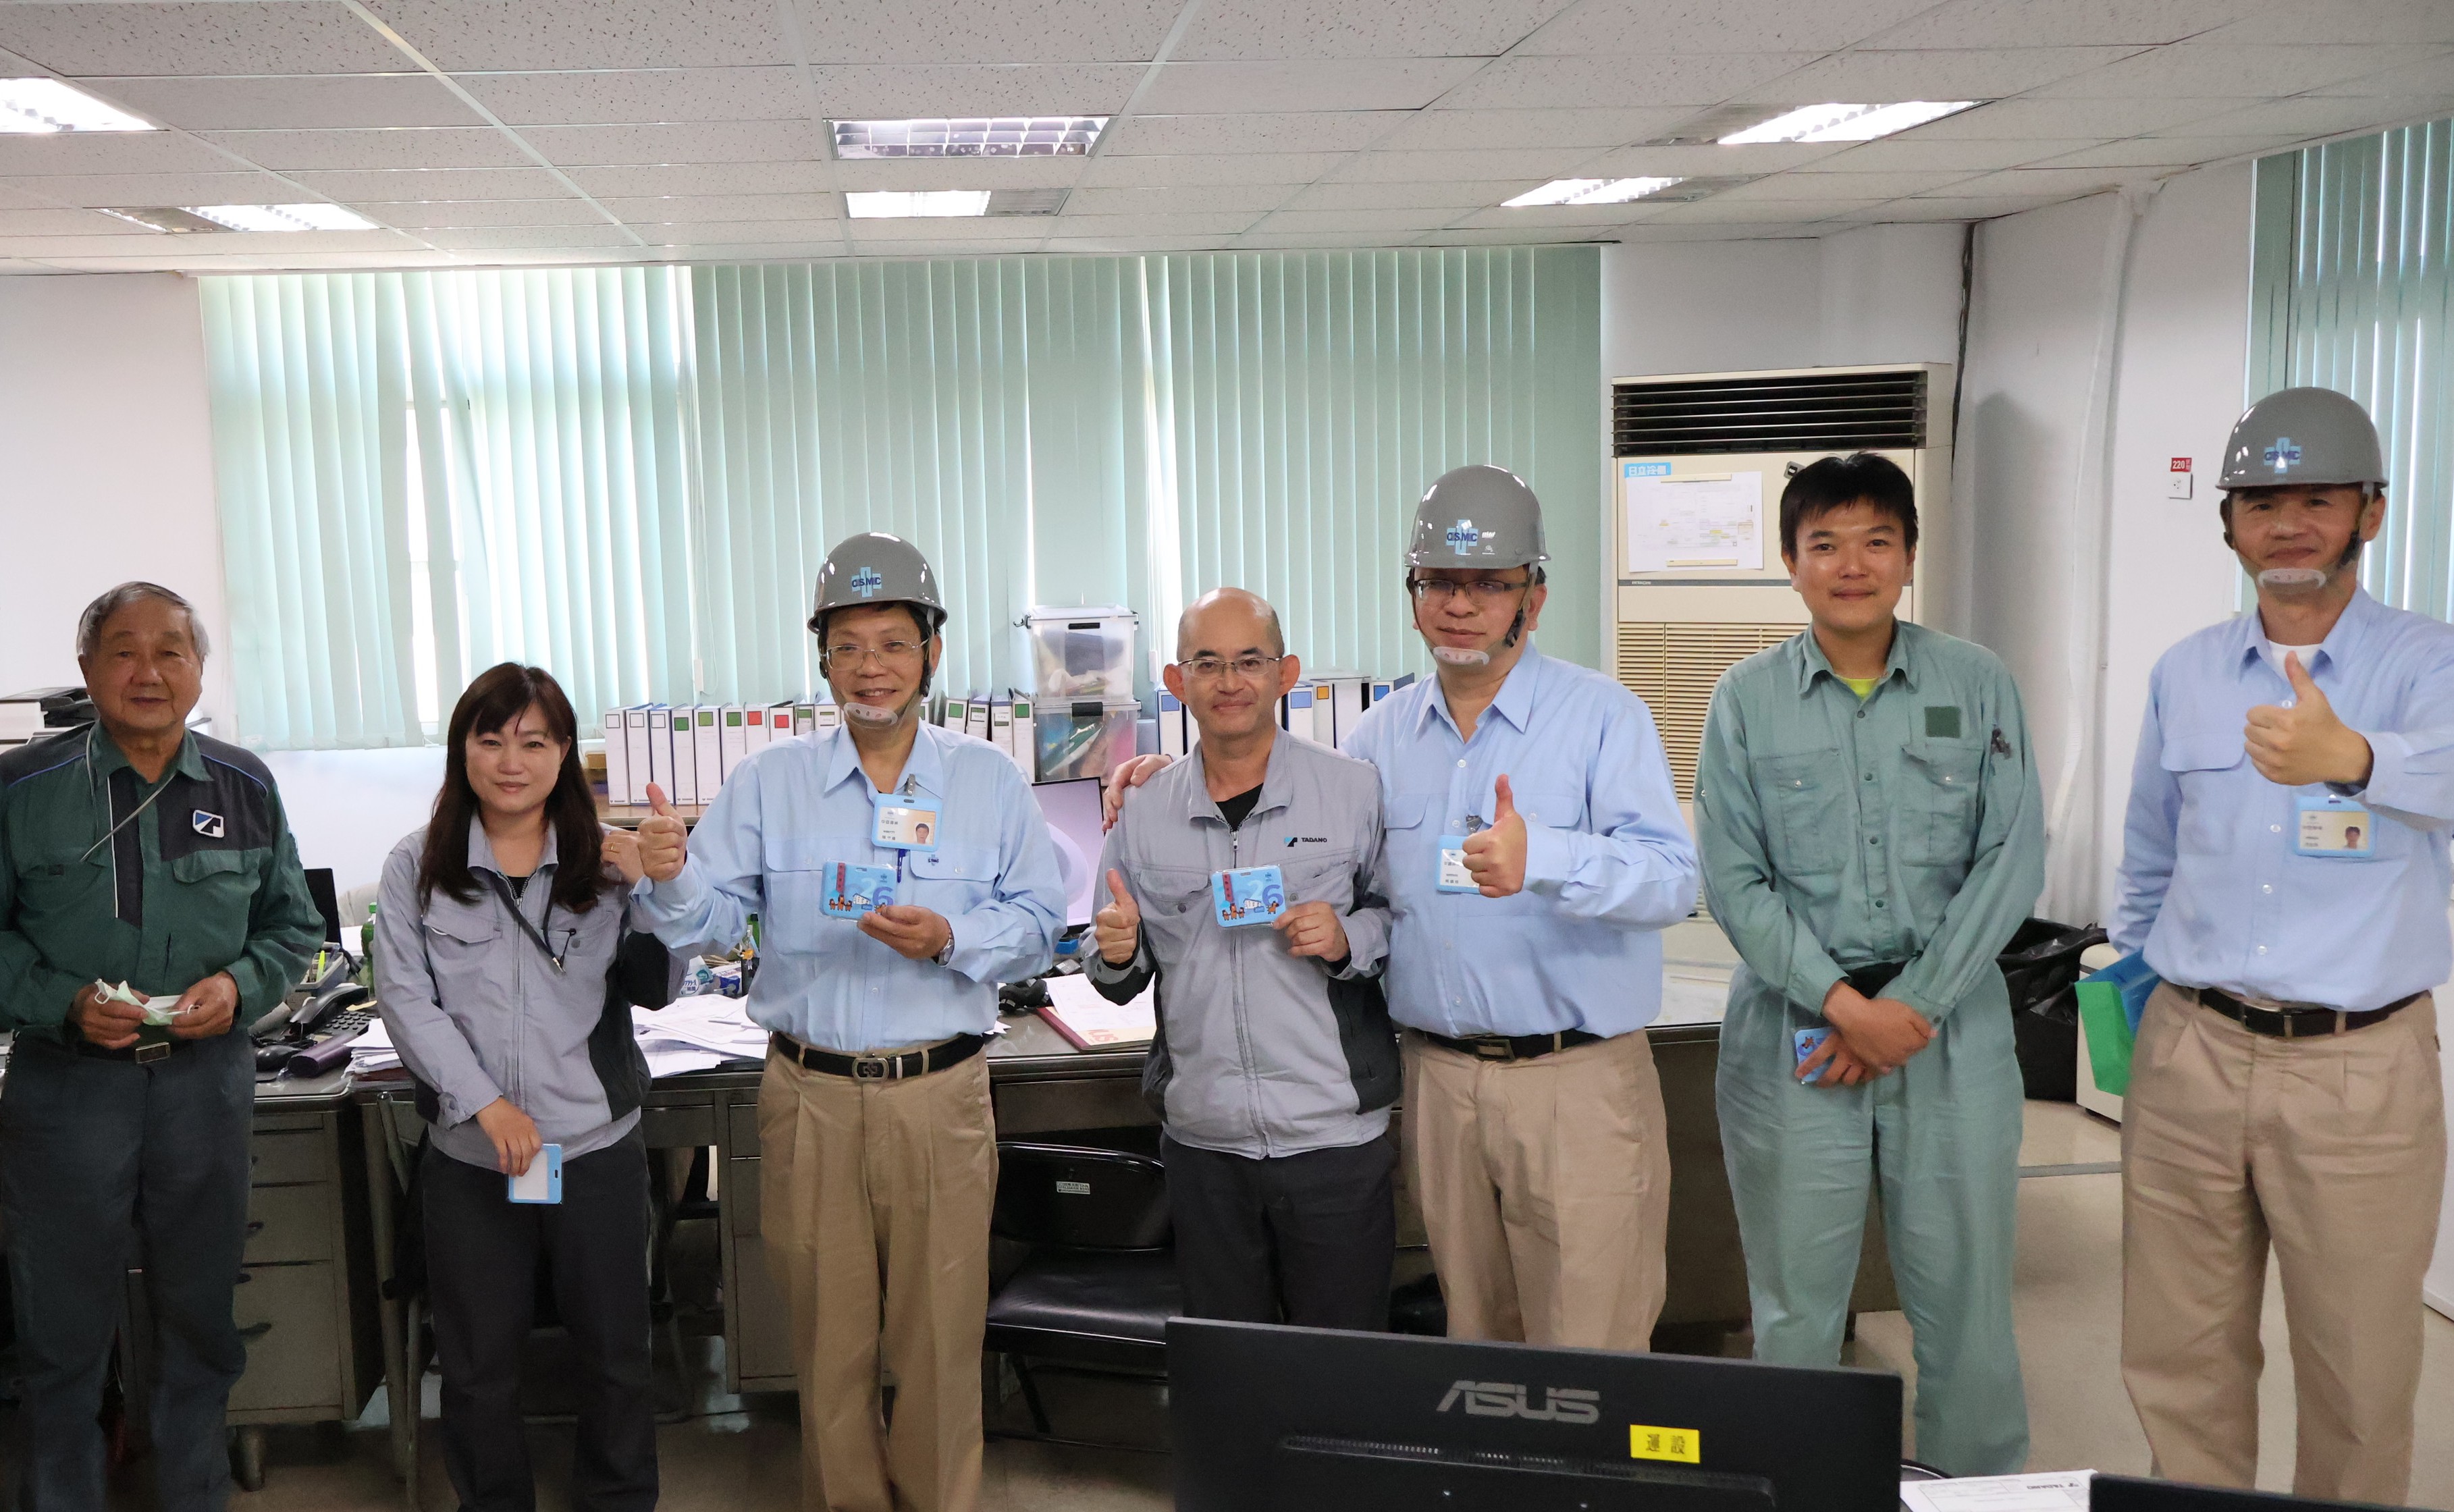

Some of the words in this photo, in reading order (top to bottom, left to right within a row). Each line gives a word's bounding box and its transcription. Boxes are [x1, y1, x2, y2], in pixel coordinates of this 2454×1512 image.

[2172, 460, 2185, 469] 220
[1447, 532, 1478, 542] CSMC
[852, 577, 882, 588] CSMC
[1436, 1380, 1601, 1425] ASUS
